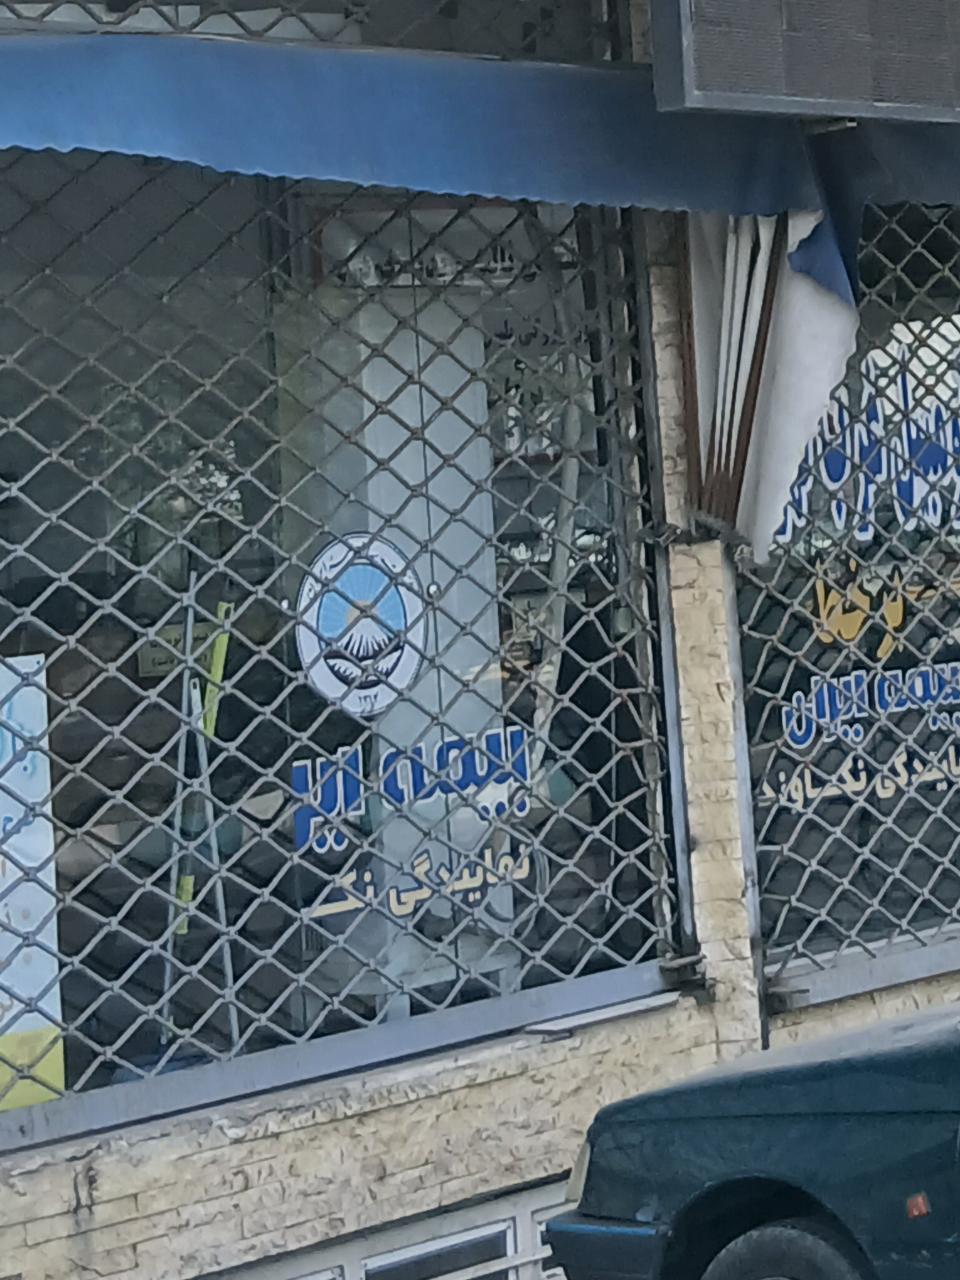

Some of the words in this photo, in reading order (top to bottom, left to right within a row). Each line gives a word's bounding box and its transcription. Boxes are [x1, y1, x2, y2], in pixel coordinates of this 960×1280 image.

[782, 670, 870, 750] ایران
[380, 725, 531, 822] بیمه
[388, 844, 531, 918] نمایندگی
